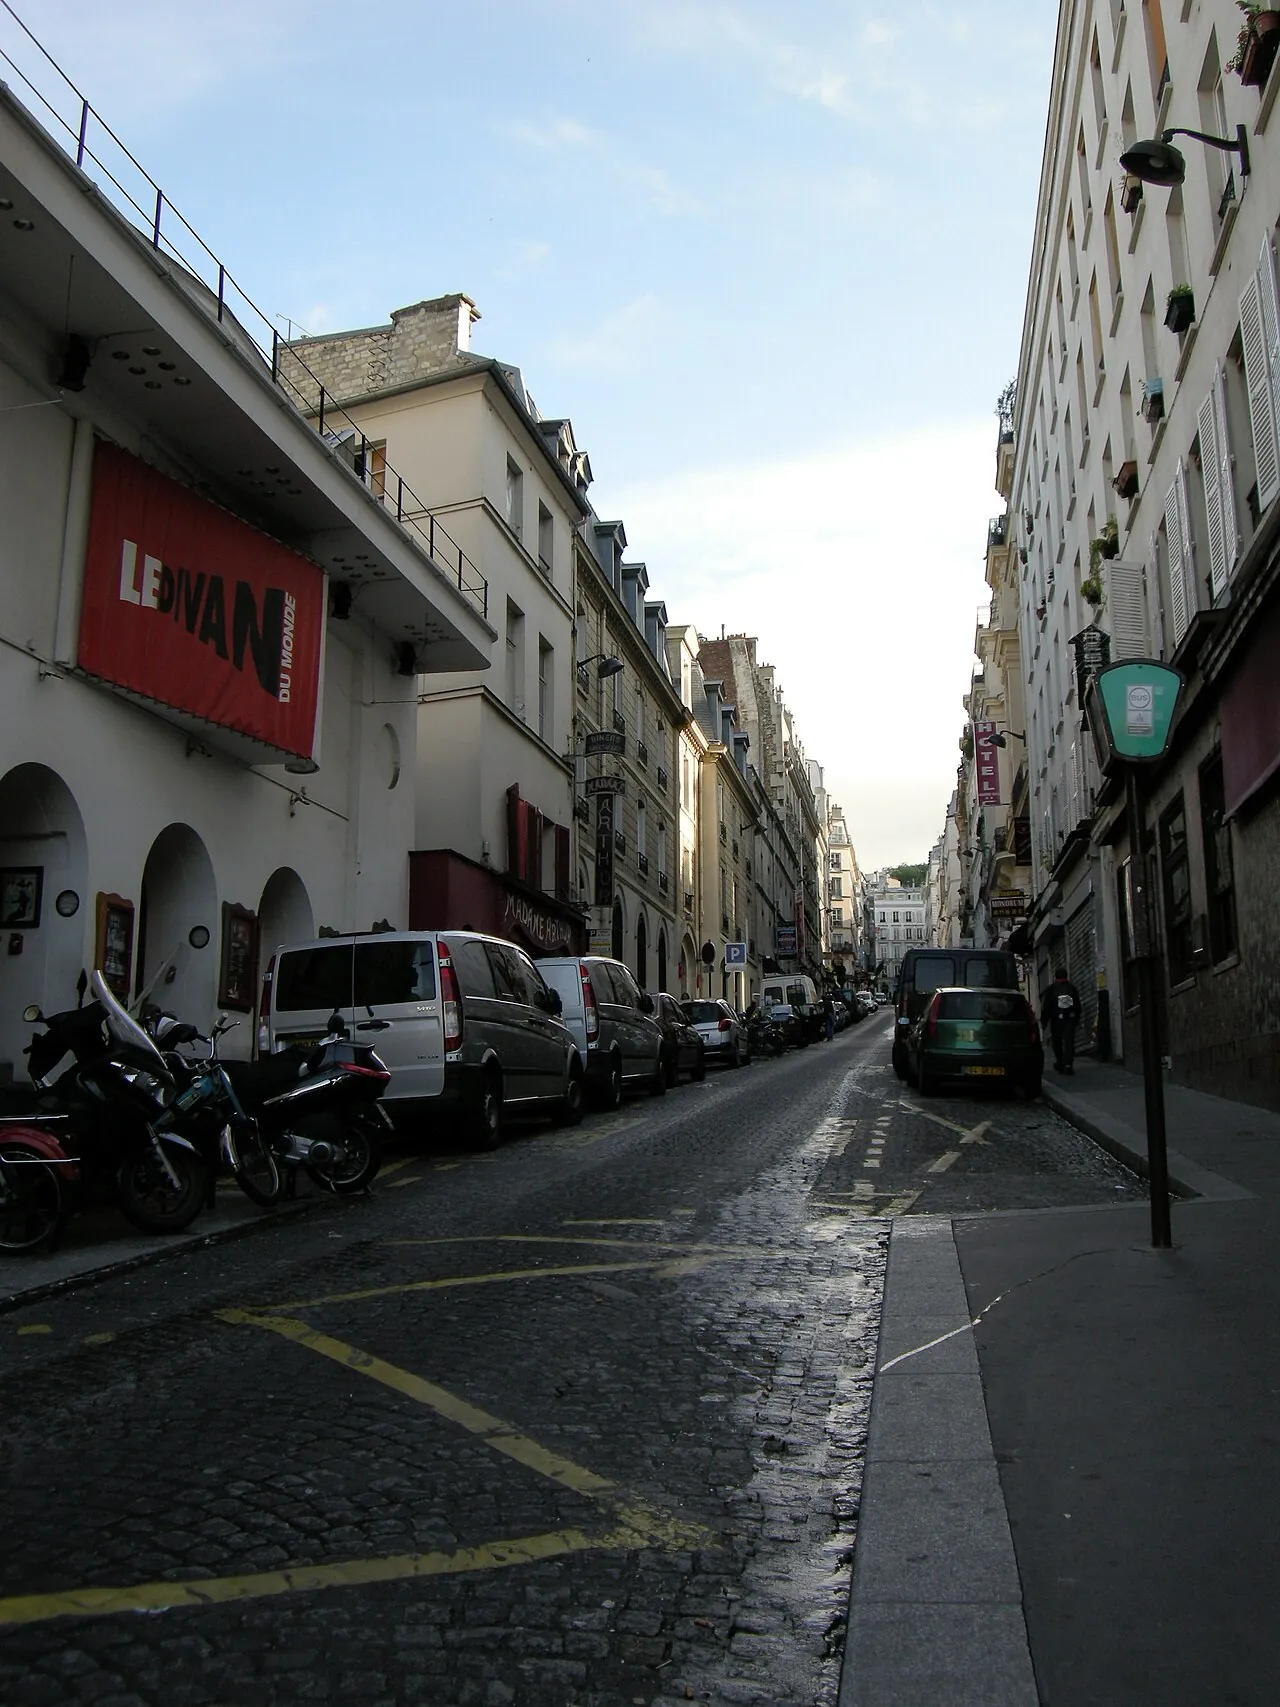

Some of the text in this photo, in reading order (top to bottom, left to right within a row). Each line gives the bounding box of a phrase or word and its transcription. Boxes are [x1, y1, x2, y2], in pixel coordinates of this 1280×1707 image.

[119, 538, 287, 698] LE DIVAN
[278, 591, 297, 703] DU MONDE
[1131, 694, 1148, 702] BUS
[977, 723, 995, 791] HOTEL
[597, 798, 612, 904] ARTHUR
[504, 891, 545, 941] MADAME
